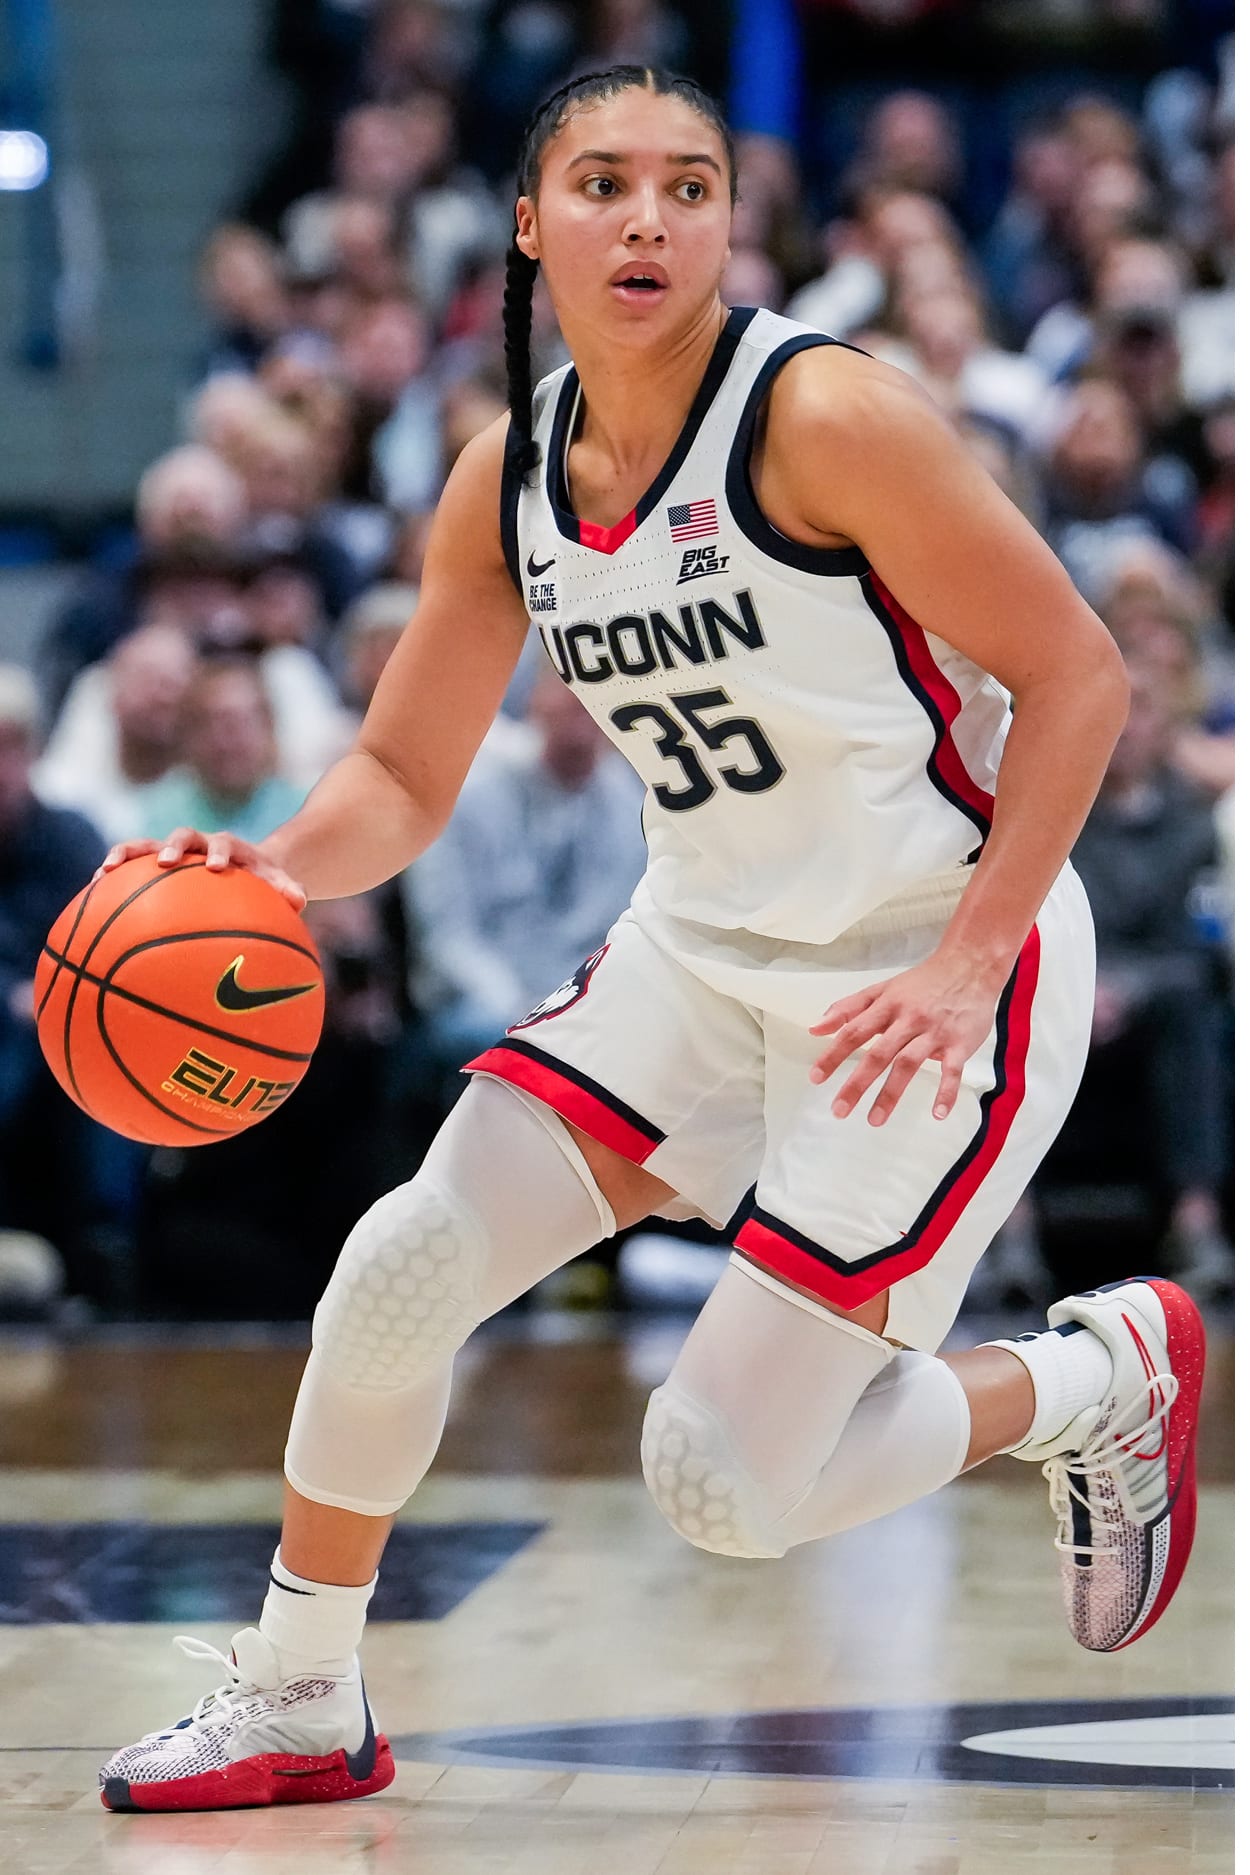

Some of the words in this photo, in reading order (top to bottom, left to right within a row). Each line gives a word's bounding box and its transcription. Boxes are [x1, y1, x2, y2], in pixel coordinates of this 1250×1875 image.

[682, 545, 717, 564] BIG
[679, 556, 730, 577] EAST
[530, 584, 539, 598] BE
[541, 583, 556, 597] THE
[529, 597, 557, 612] CHANGE
[537, 587, 768, 686] UCONN
[608, 685, 787, 813] 35
[169, 1047, 297, 1112] ELITE
